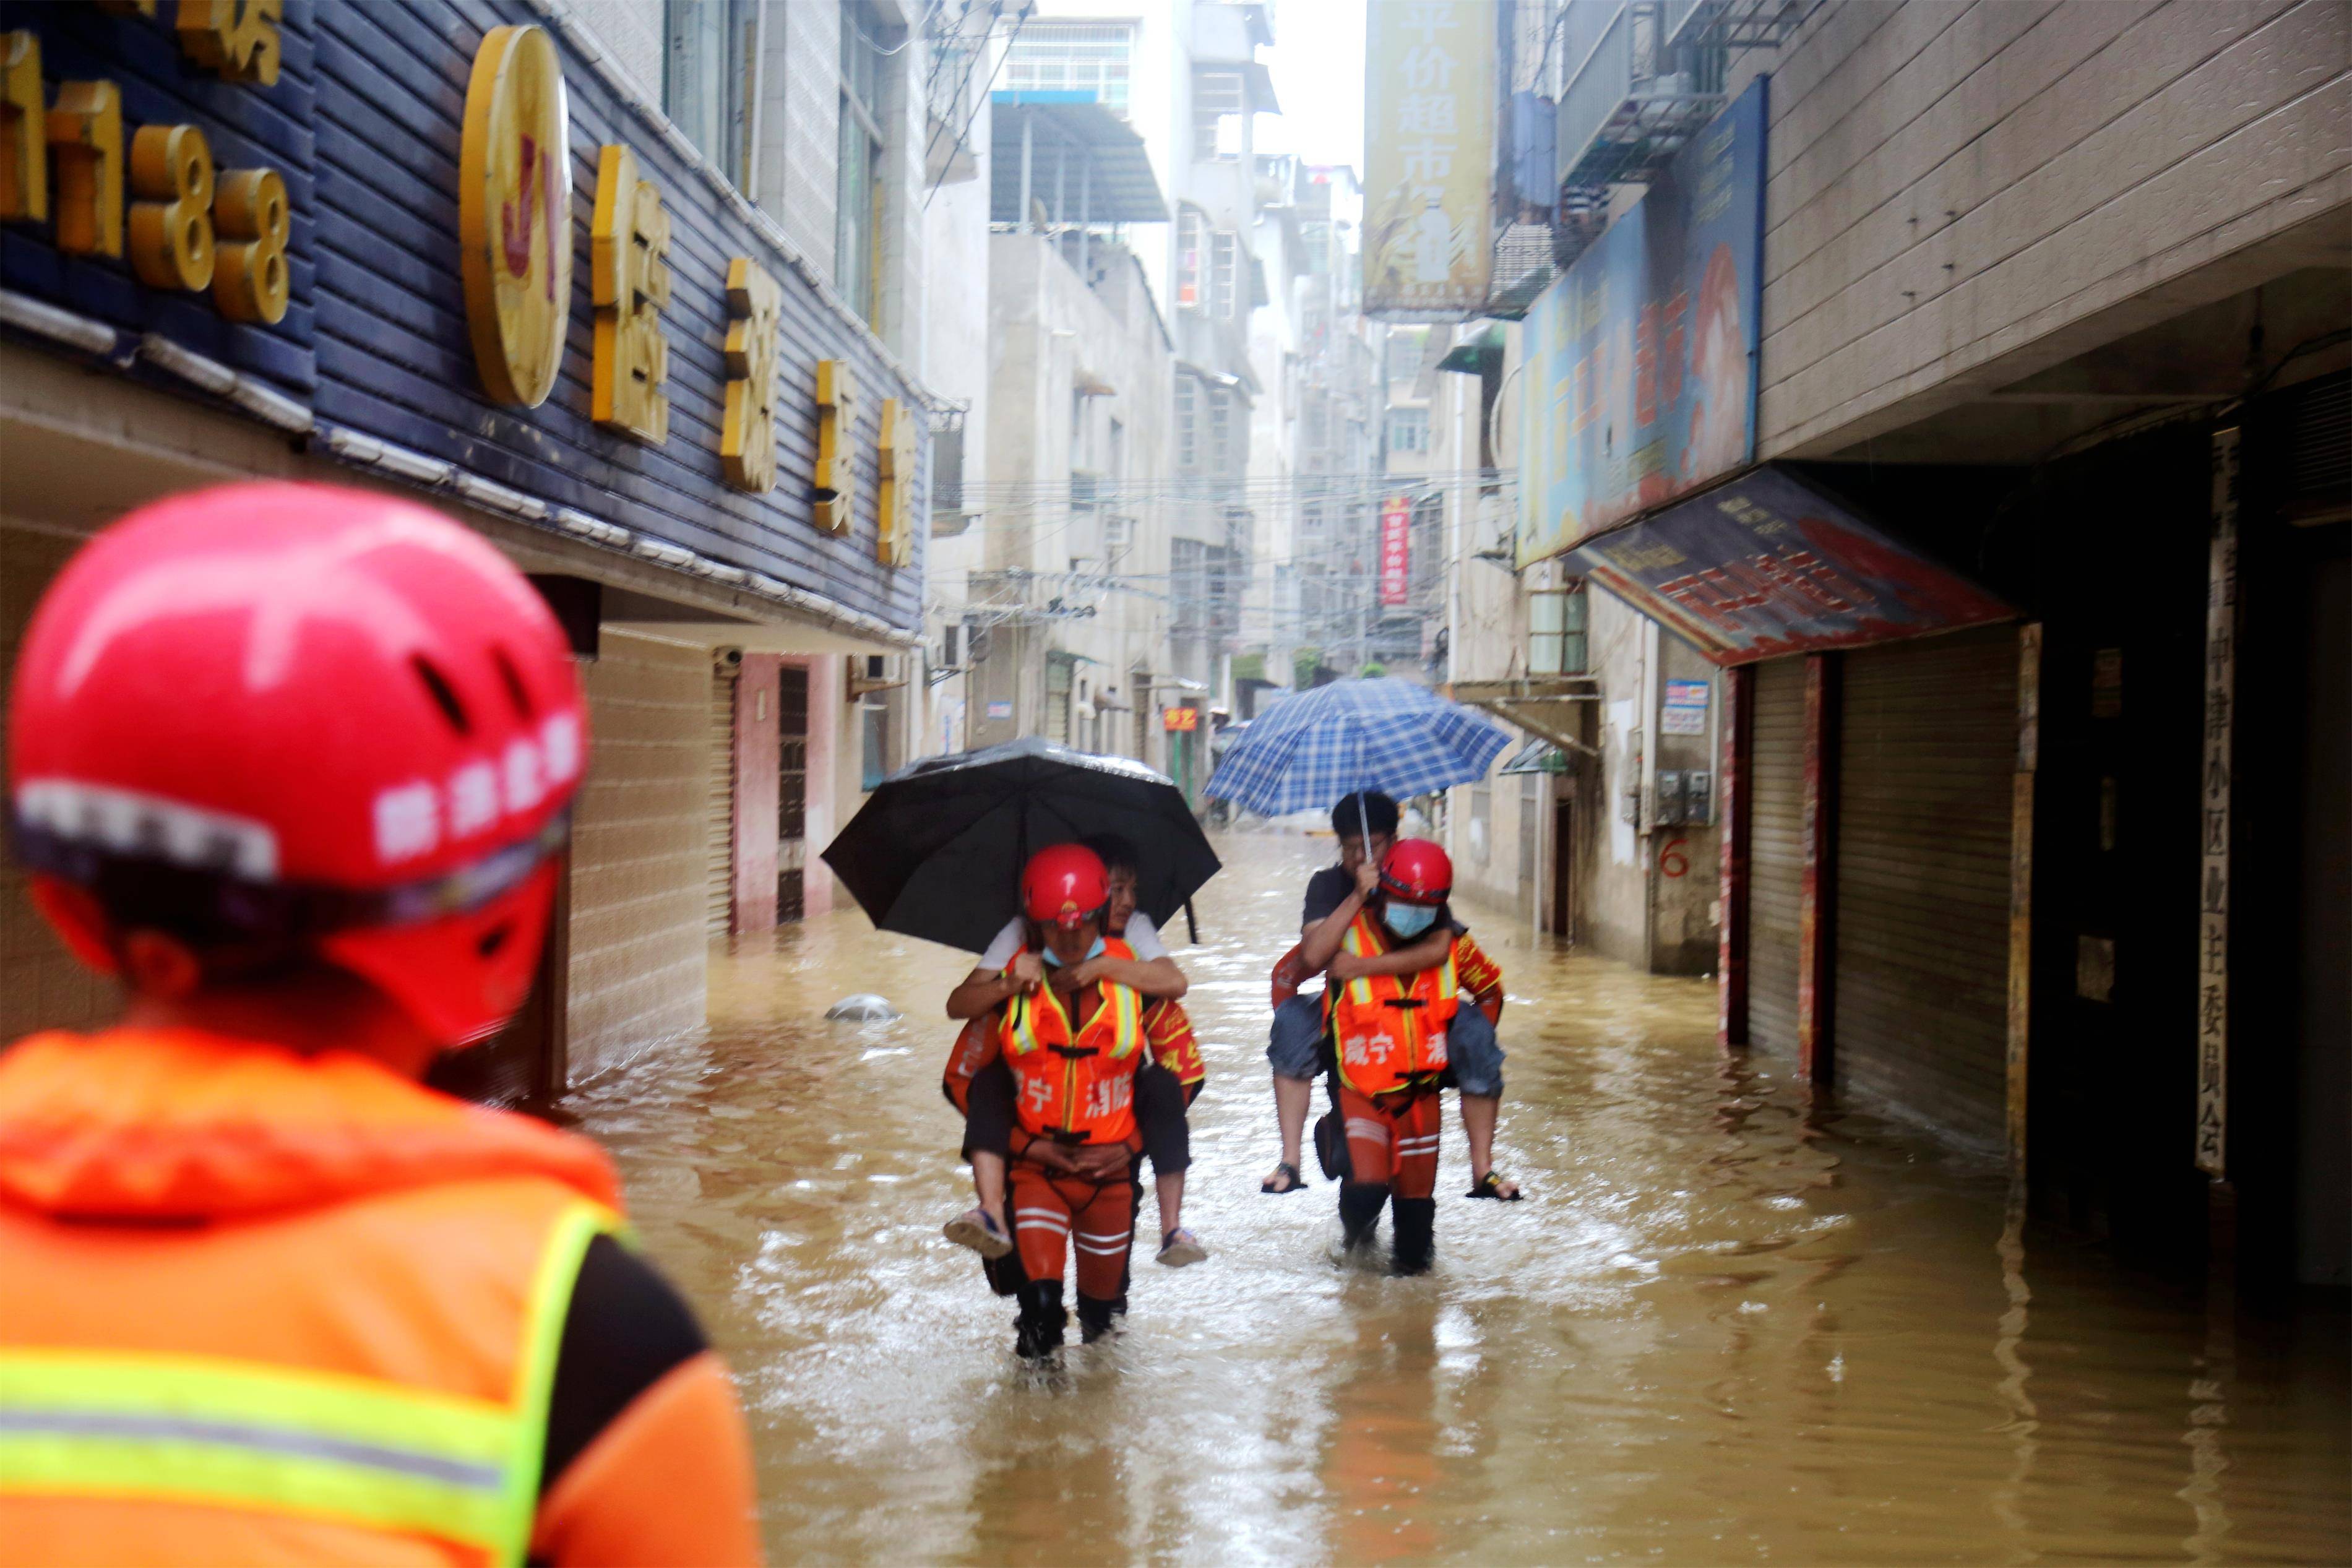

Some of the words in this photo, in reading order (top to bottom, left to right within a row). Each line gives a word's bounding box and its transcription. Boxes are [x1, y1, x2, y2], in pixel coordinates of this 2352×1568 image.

[1397, 0, 1460, 181] 平价超市
[1659, 838, 1690, 878] 6
[1345, 1032, 1395, 1066] 咸宁
